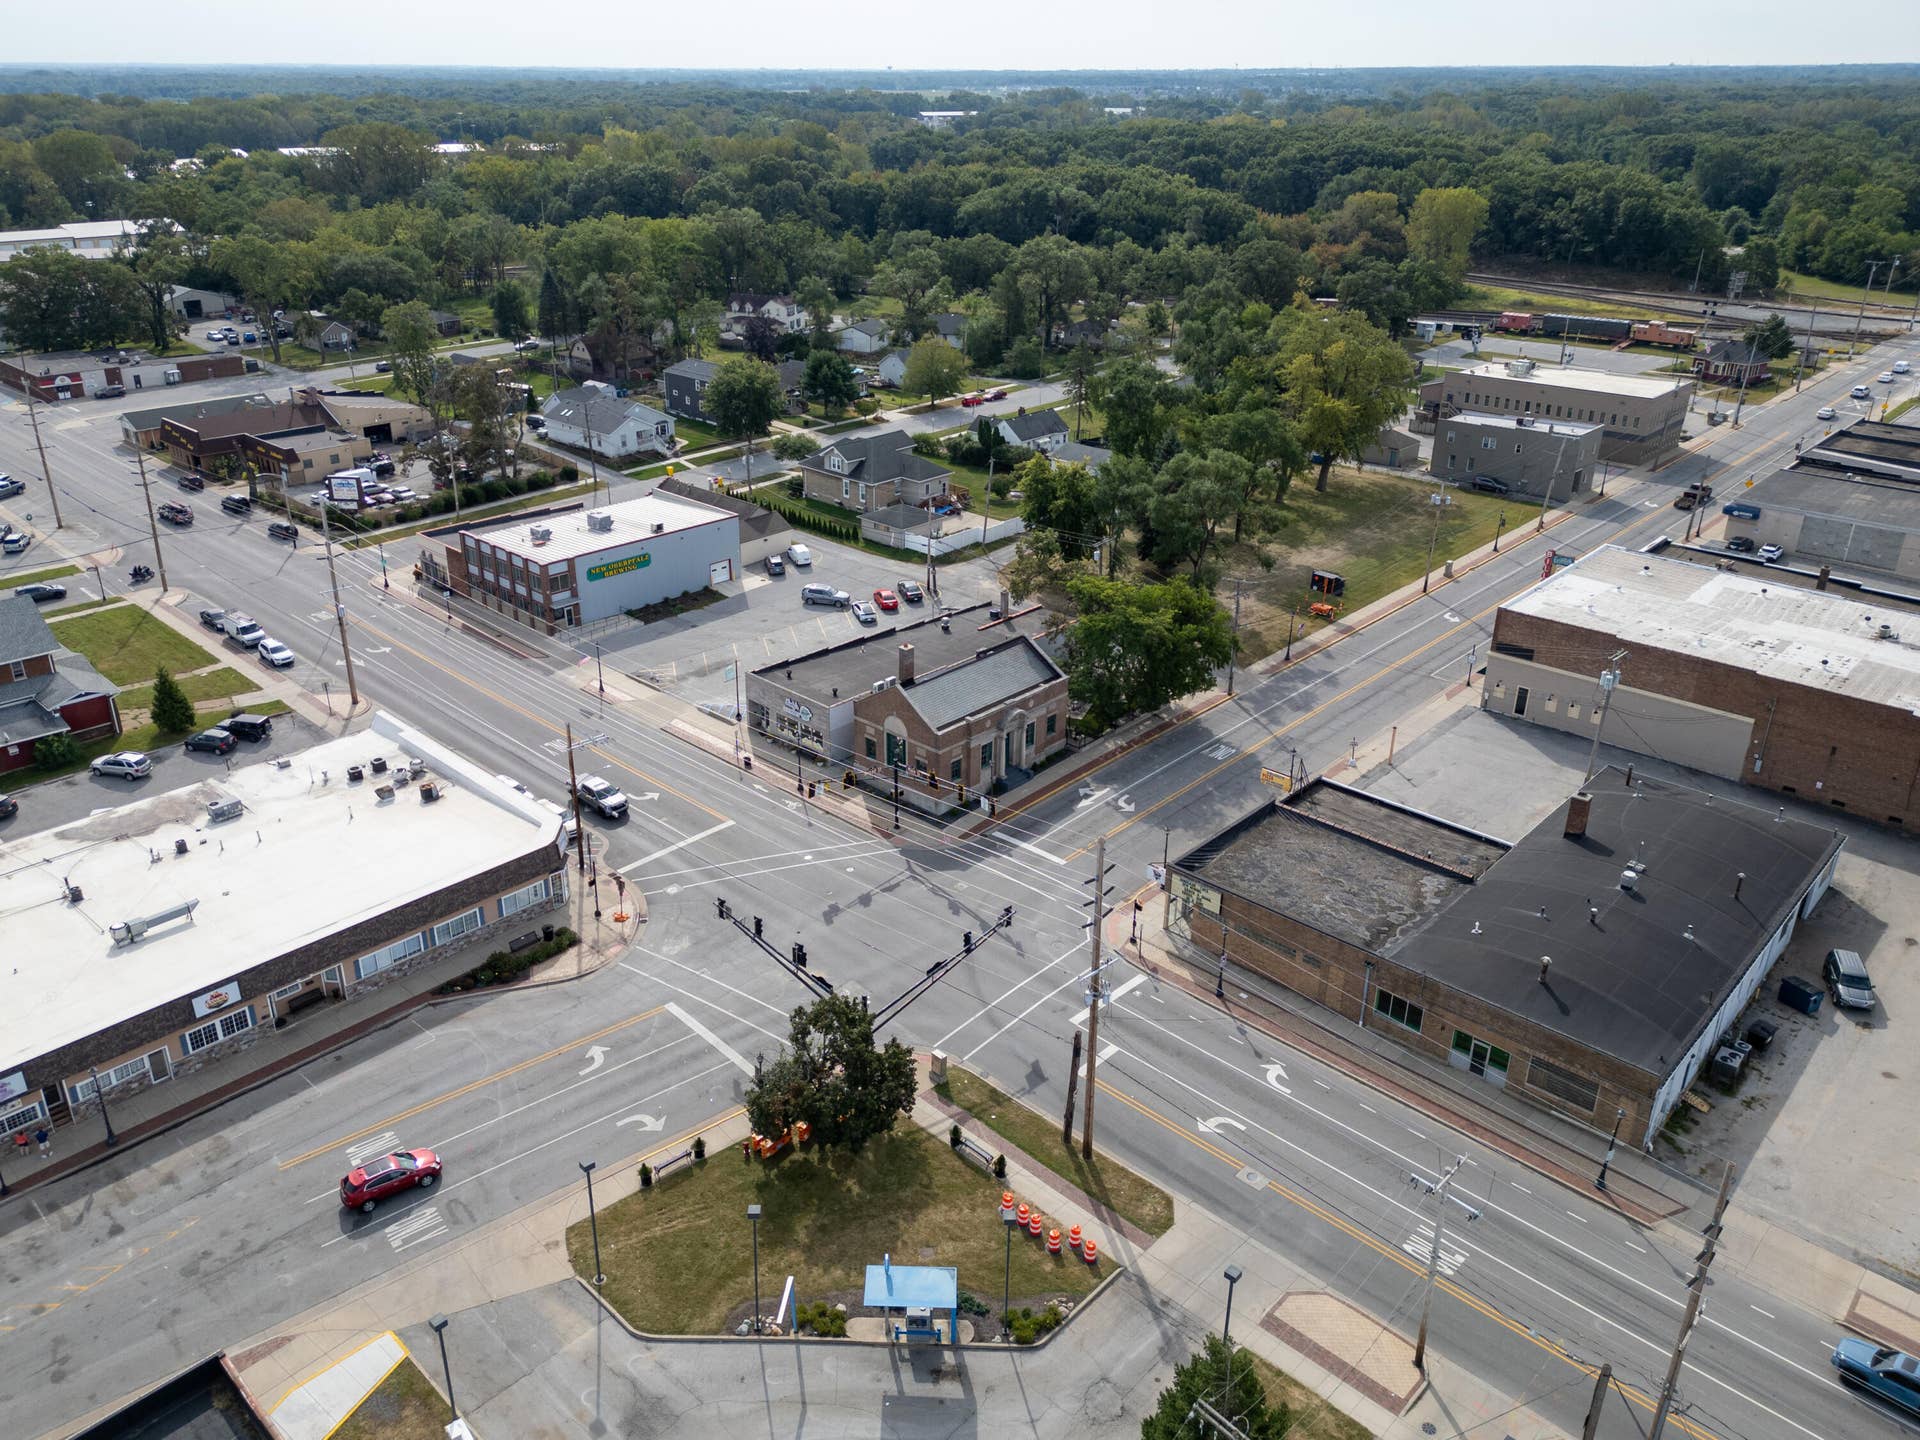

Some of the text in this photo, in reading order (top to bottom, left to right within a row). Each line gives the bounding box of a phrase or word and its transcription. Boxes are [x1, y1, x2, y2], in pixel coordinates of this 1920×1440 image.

[590, 554, 649, 575] NEW OBERPFALZ
[603, 563, 638, 577] BREWING
[384, 1207, 449, 1253] ONLY
[1402, 1224, 1470, 1275] ONLY
